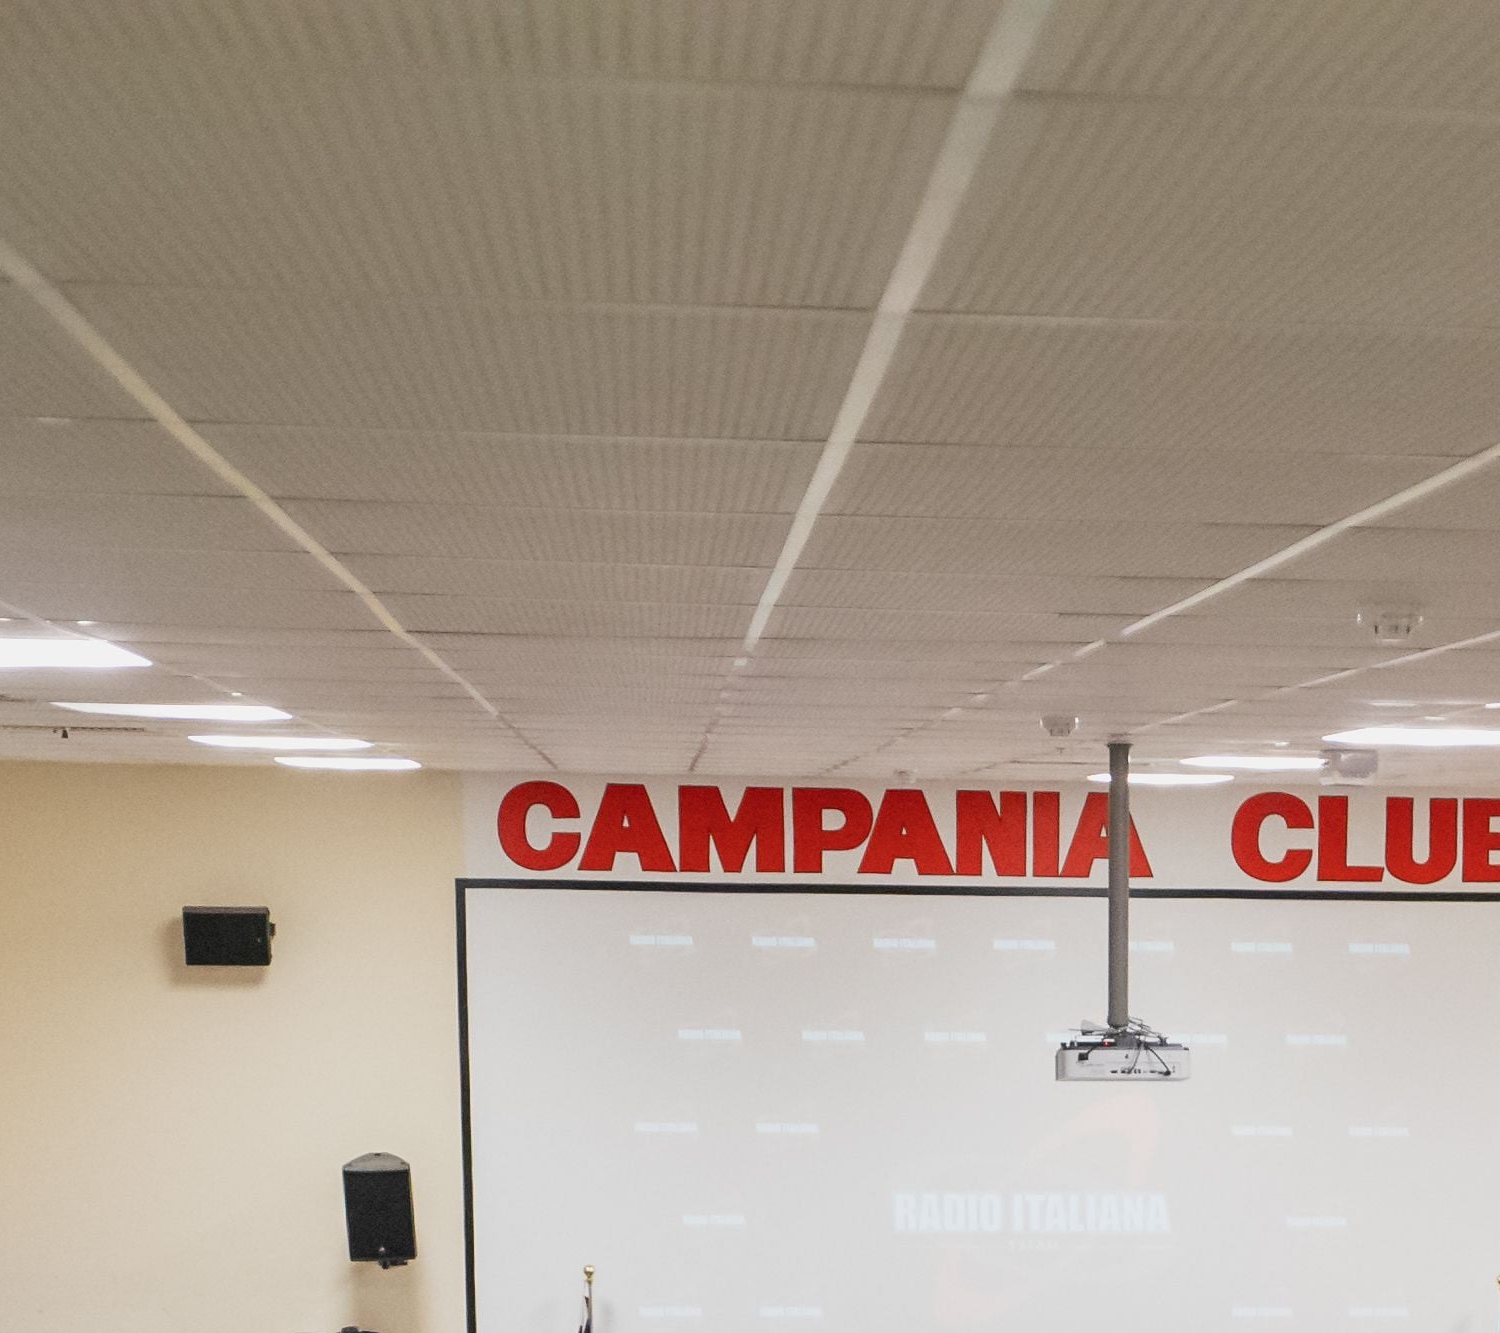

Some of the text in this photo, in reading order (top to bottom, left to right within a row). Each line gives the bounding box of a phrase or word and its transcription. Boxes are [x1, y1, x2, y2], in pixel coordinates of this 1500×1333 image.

[499, 783, 1152, 877] CAMPANIA
[893, 1190, 1170, 1233] RADIO ITALIANA
